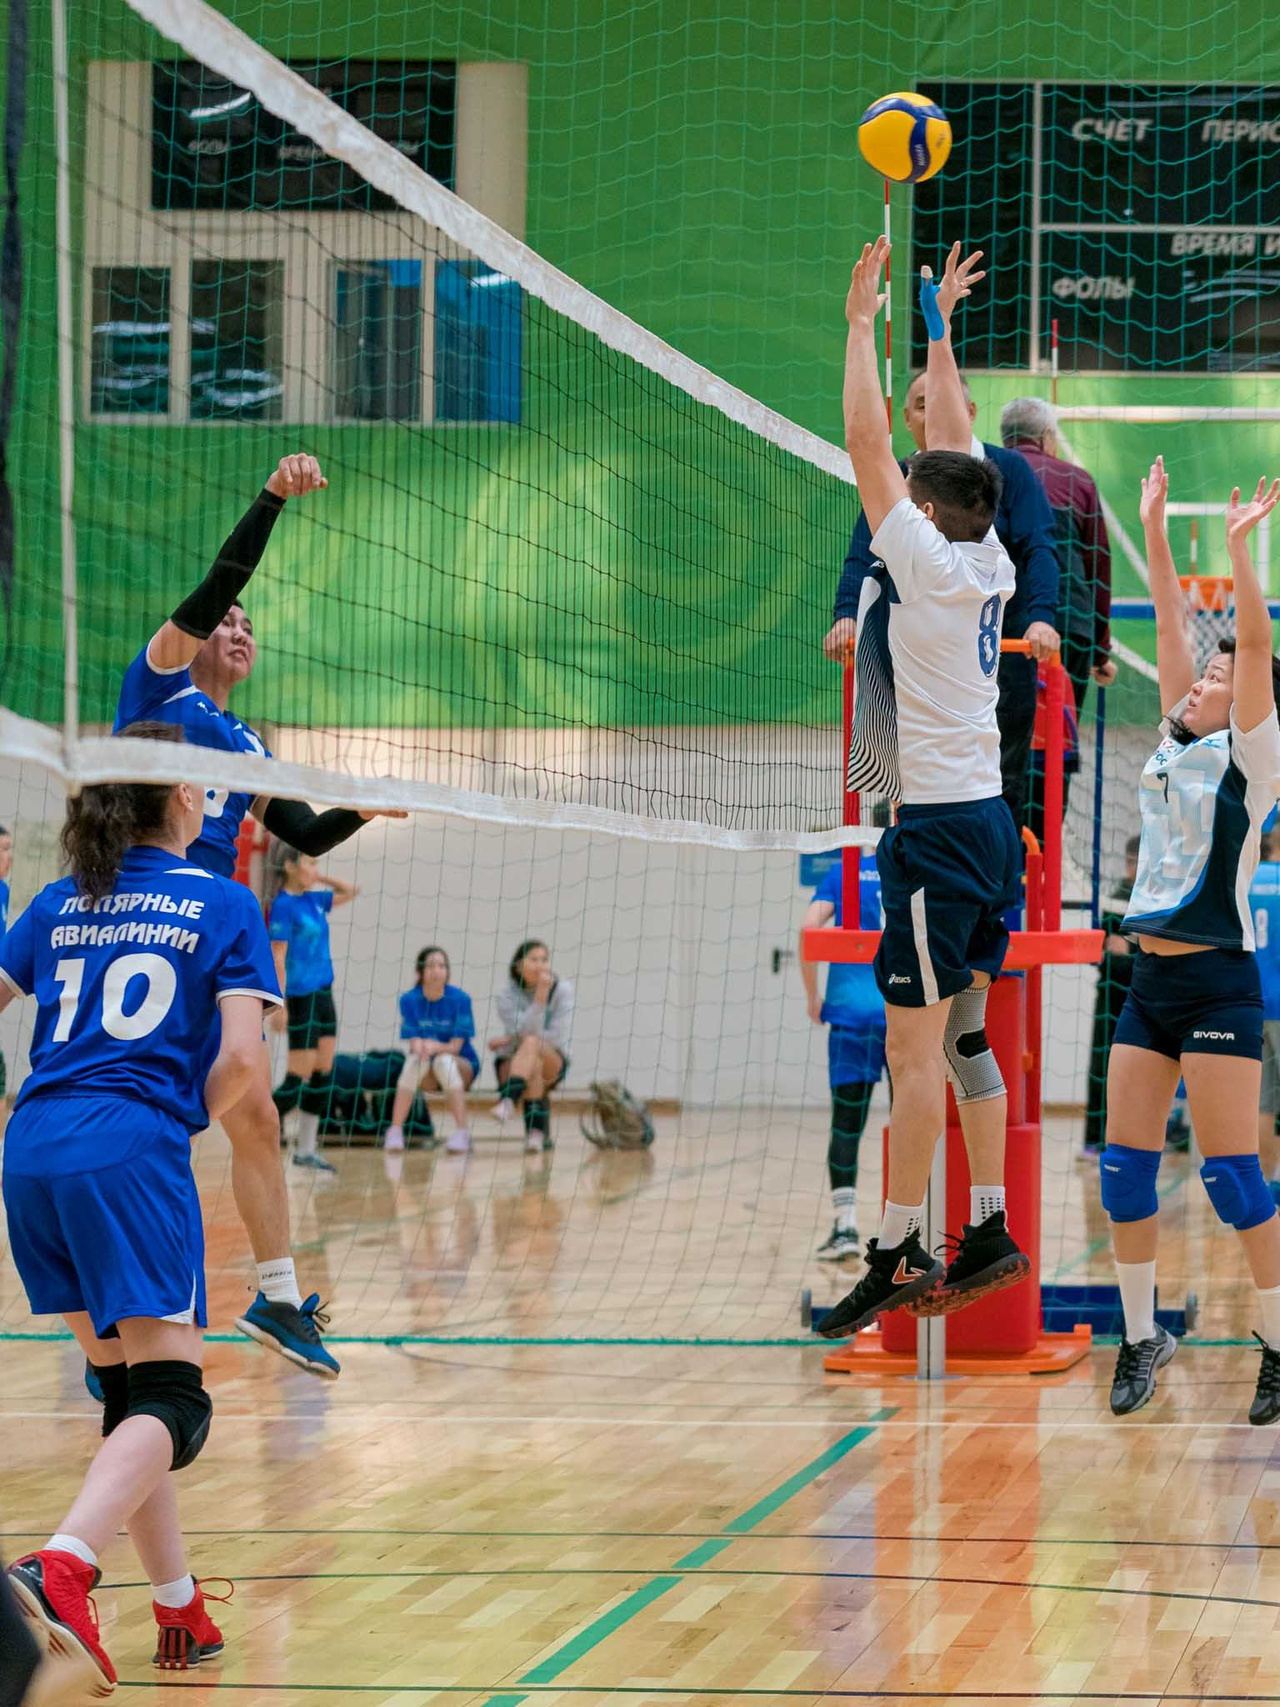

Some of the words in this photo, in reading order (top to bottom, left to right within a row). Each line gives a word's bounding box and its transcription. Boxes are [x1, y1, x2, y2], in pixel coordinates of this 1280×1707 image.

[1072, 118, 1153, 142] СЧЕТ
[1171, 234, 1256, 257] ВРЕМЯ
[1052, 276, 1135, 299] ФОЛЫ
[979, 594, 1000, 677] 8
[50, 921, 200, 954] АВИАЛИНИИ
[52, 952, 178, 1043] 10
[1193, 1030, 1235, 1041] GIVOVA
